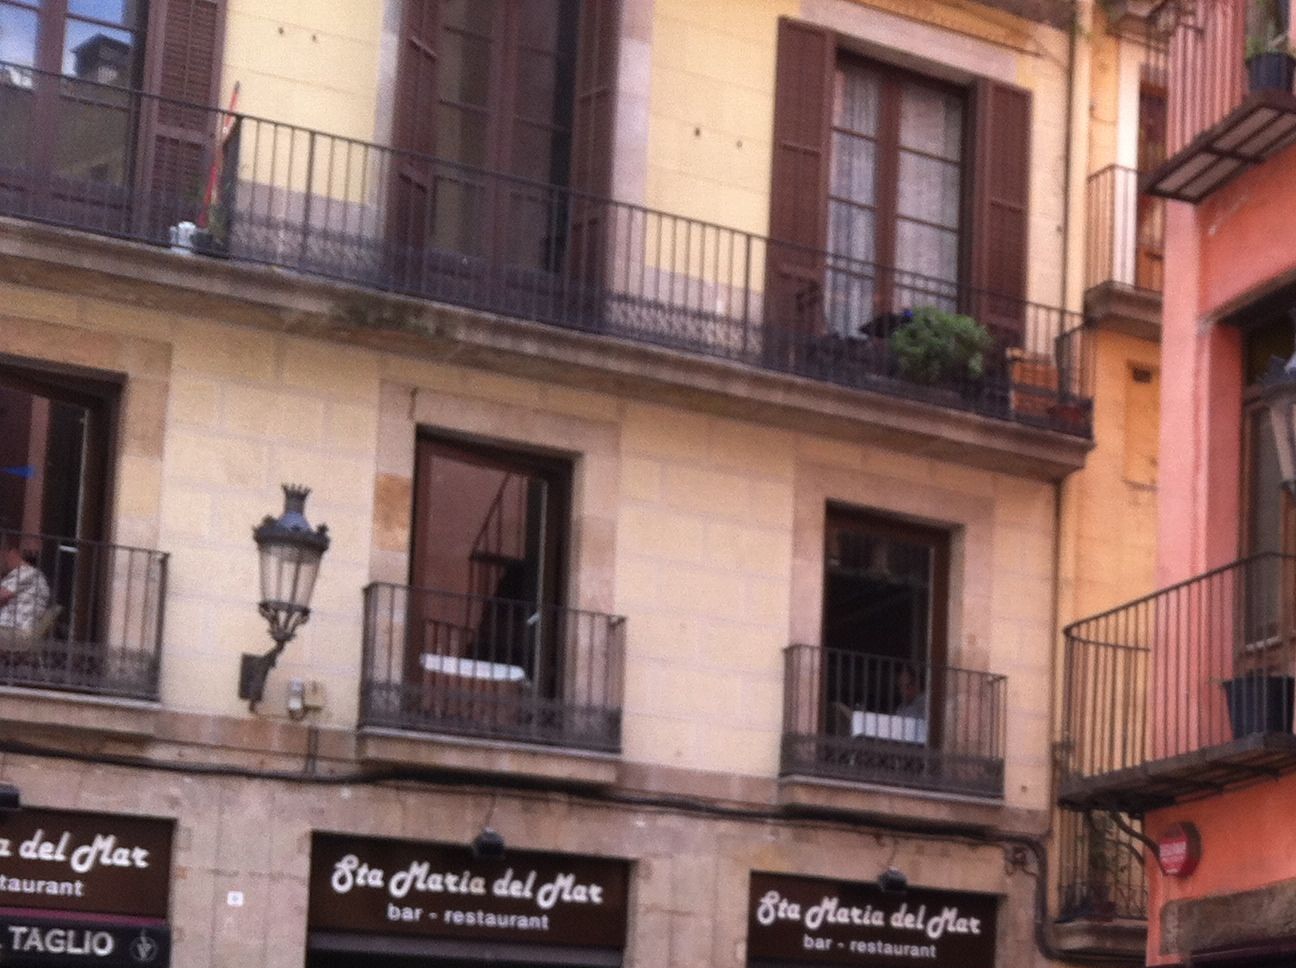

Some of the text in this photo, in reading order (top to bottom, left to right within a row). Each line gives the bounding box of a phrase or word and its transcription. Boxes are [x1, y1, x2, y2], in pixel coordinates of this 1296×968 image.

[19, 828, 71, 862] del
[70, 834, 149, 873] Mar
[331, 854, 603, 909] Sta Maria del Mar
[387, 903, 424, 921] bar
[444, 909, 549, 930] restaurant
[757, 890, 981, 940] Sta Maria del Mar
[8, 925, 115, 956] TAGLIO
[803, 934, 833, 950] bar
[850, 938, 937, 959] restaurant
